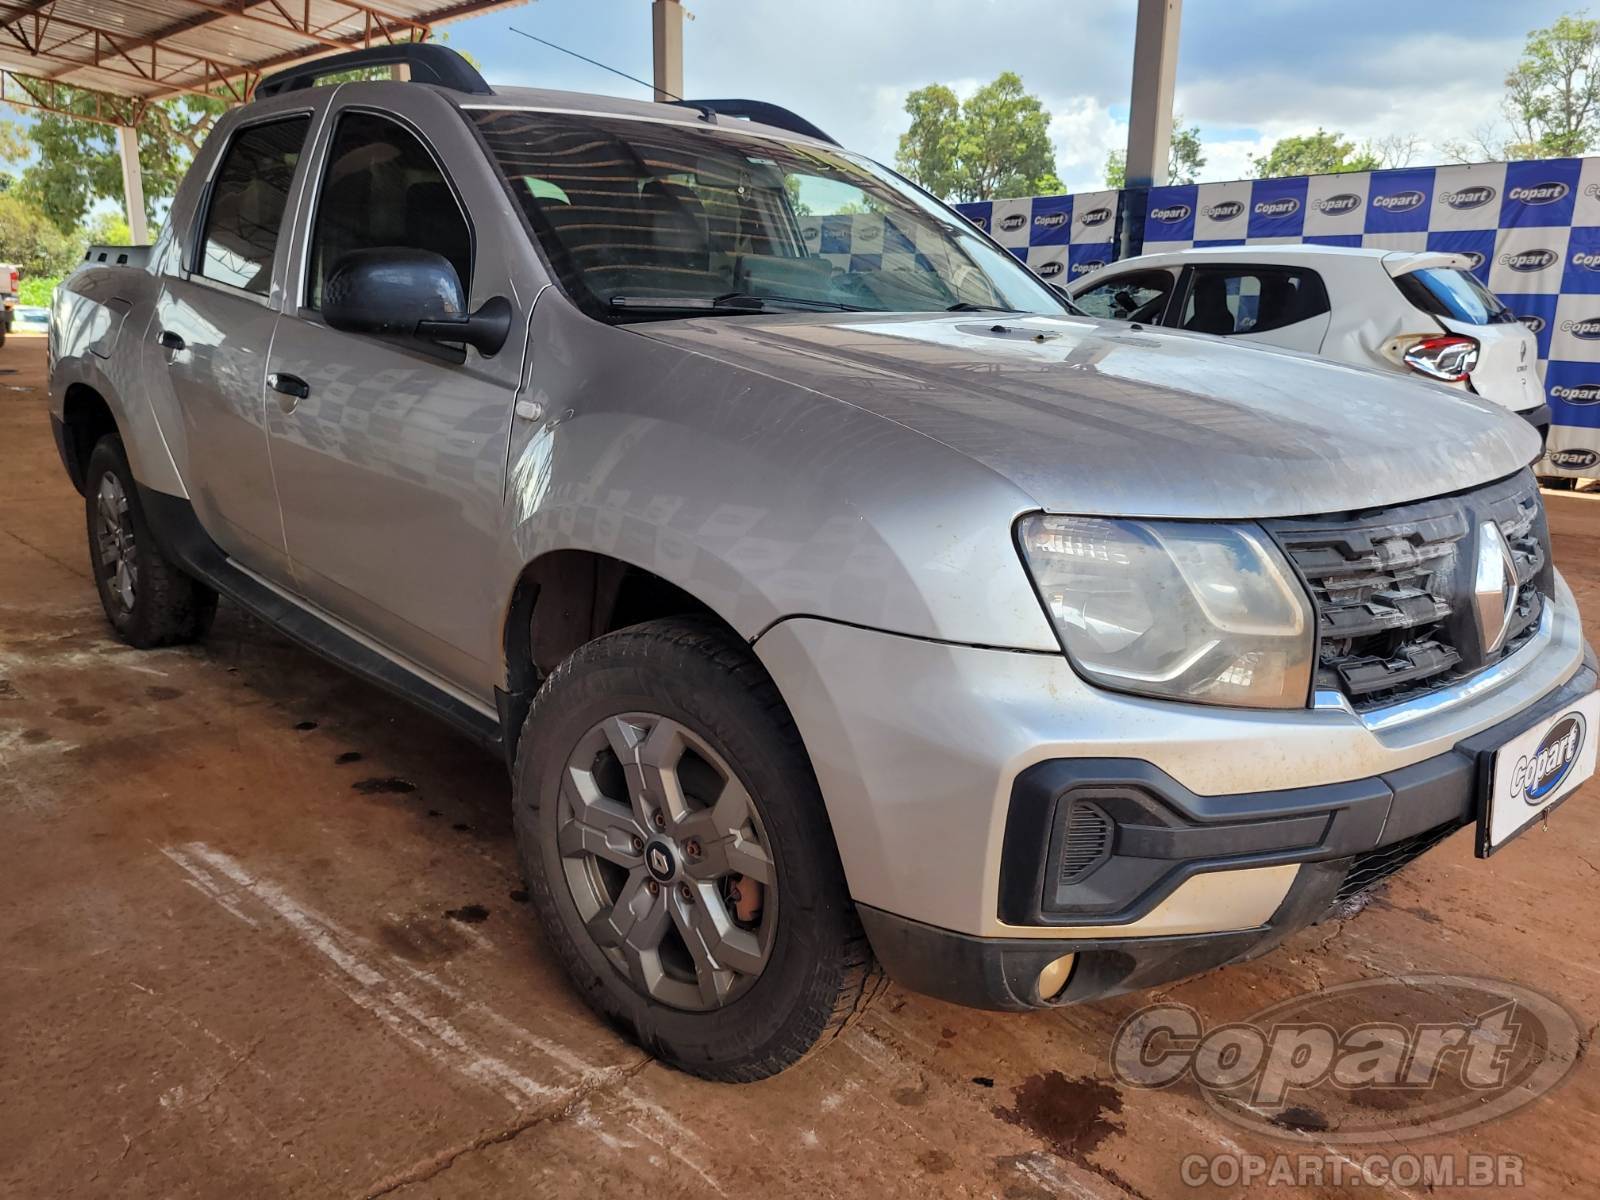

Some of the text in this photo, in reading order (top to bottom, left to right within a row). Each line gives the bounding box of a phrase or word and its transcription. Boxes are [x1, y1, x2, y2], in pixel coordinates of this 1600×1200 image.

[1439, 191, 1486, 206] Copart
[1508, 187, 1562, 201] Copart
[1311, 199, 1355, 211] Copart
[1372, 195, 1418, 208] Copart
[1150, 208, 1186, 220] Copart
[1202, 204, 1238, 216] Copart
[1254, 202, 1294, 215] Copart
[1034, 214, 1064, 225] Copart
[1081, 210, 1107, 223] opart
[1498, 253, 1549, 268] Copart
[1510, 719, 1578, 799] Copart
